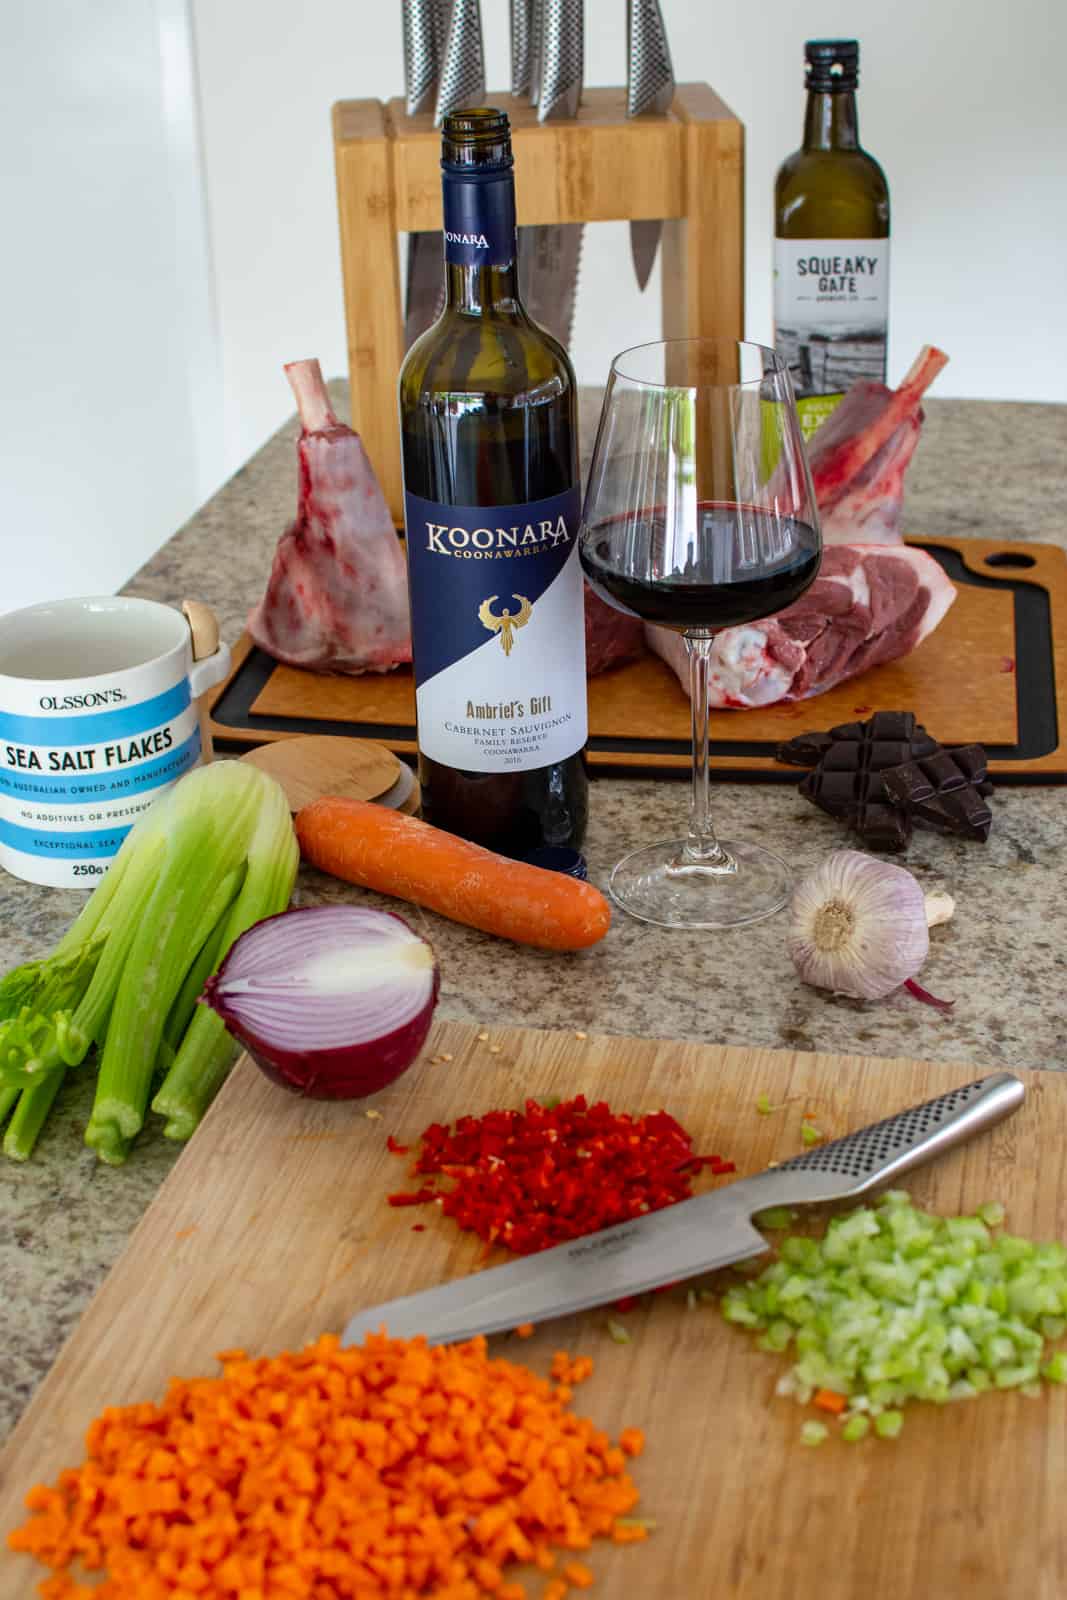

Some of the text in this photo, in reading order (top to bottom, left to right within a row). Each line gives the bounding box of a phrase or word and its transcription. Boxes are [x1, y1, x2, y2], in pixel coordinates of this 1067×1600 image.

[445, 231, 490, 249] ONARA
[797, 256, 878, 276] SQUEAKY
[818, 276, 857, 293] GATE
[425, 516, 570, 554] KOONARA
[454, 544, 548, 560] COONAWARRA
[466, 696, 552, 720] Ambriel's Gift
[444, 712, 572, 737] CABERNET SAUVIGNON
[474, 733, 547, 746] FAMILY RESERVE
[6, 727, 173, 771] SEA SALT FLAKES
[14, 783, 66, 794] AUSTRALIAN
[70, 784, 106, 794] OWNED
[111, 779, 130, 790] AND
[36, 813, 84, 822] ADDITIVES
[88, 813, 103, 822] OR
[33, 839, 94, 849] EXCEPTIONAL
[98, 839, 116, 848] SEA
